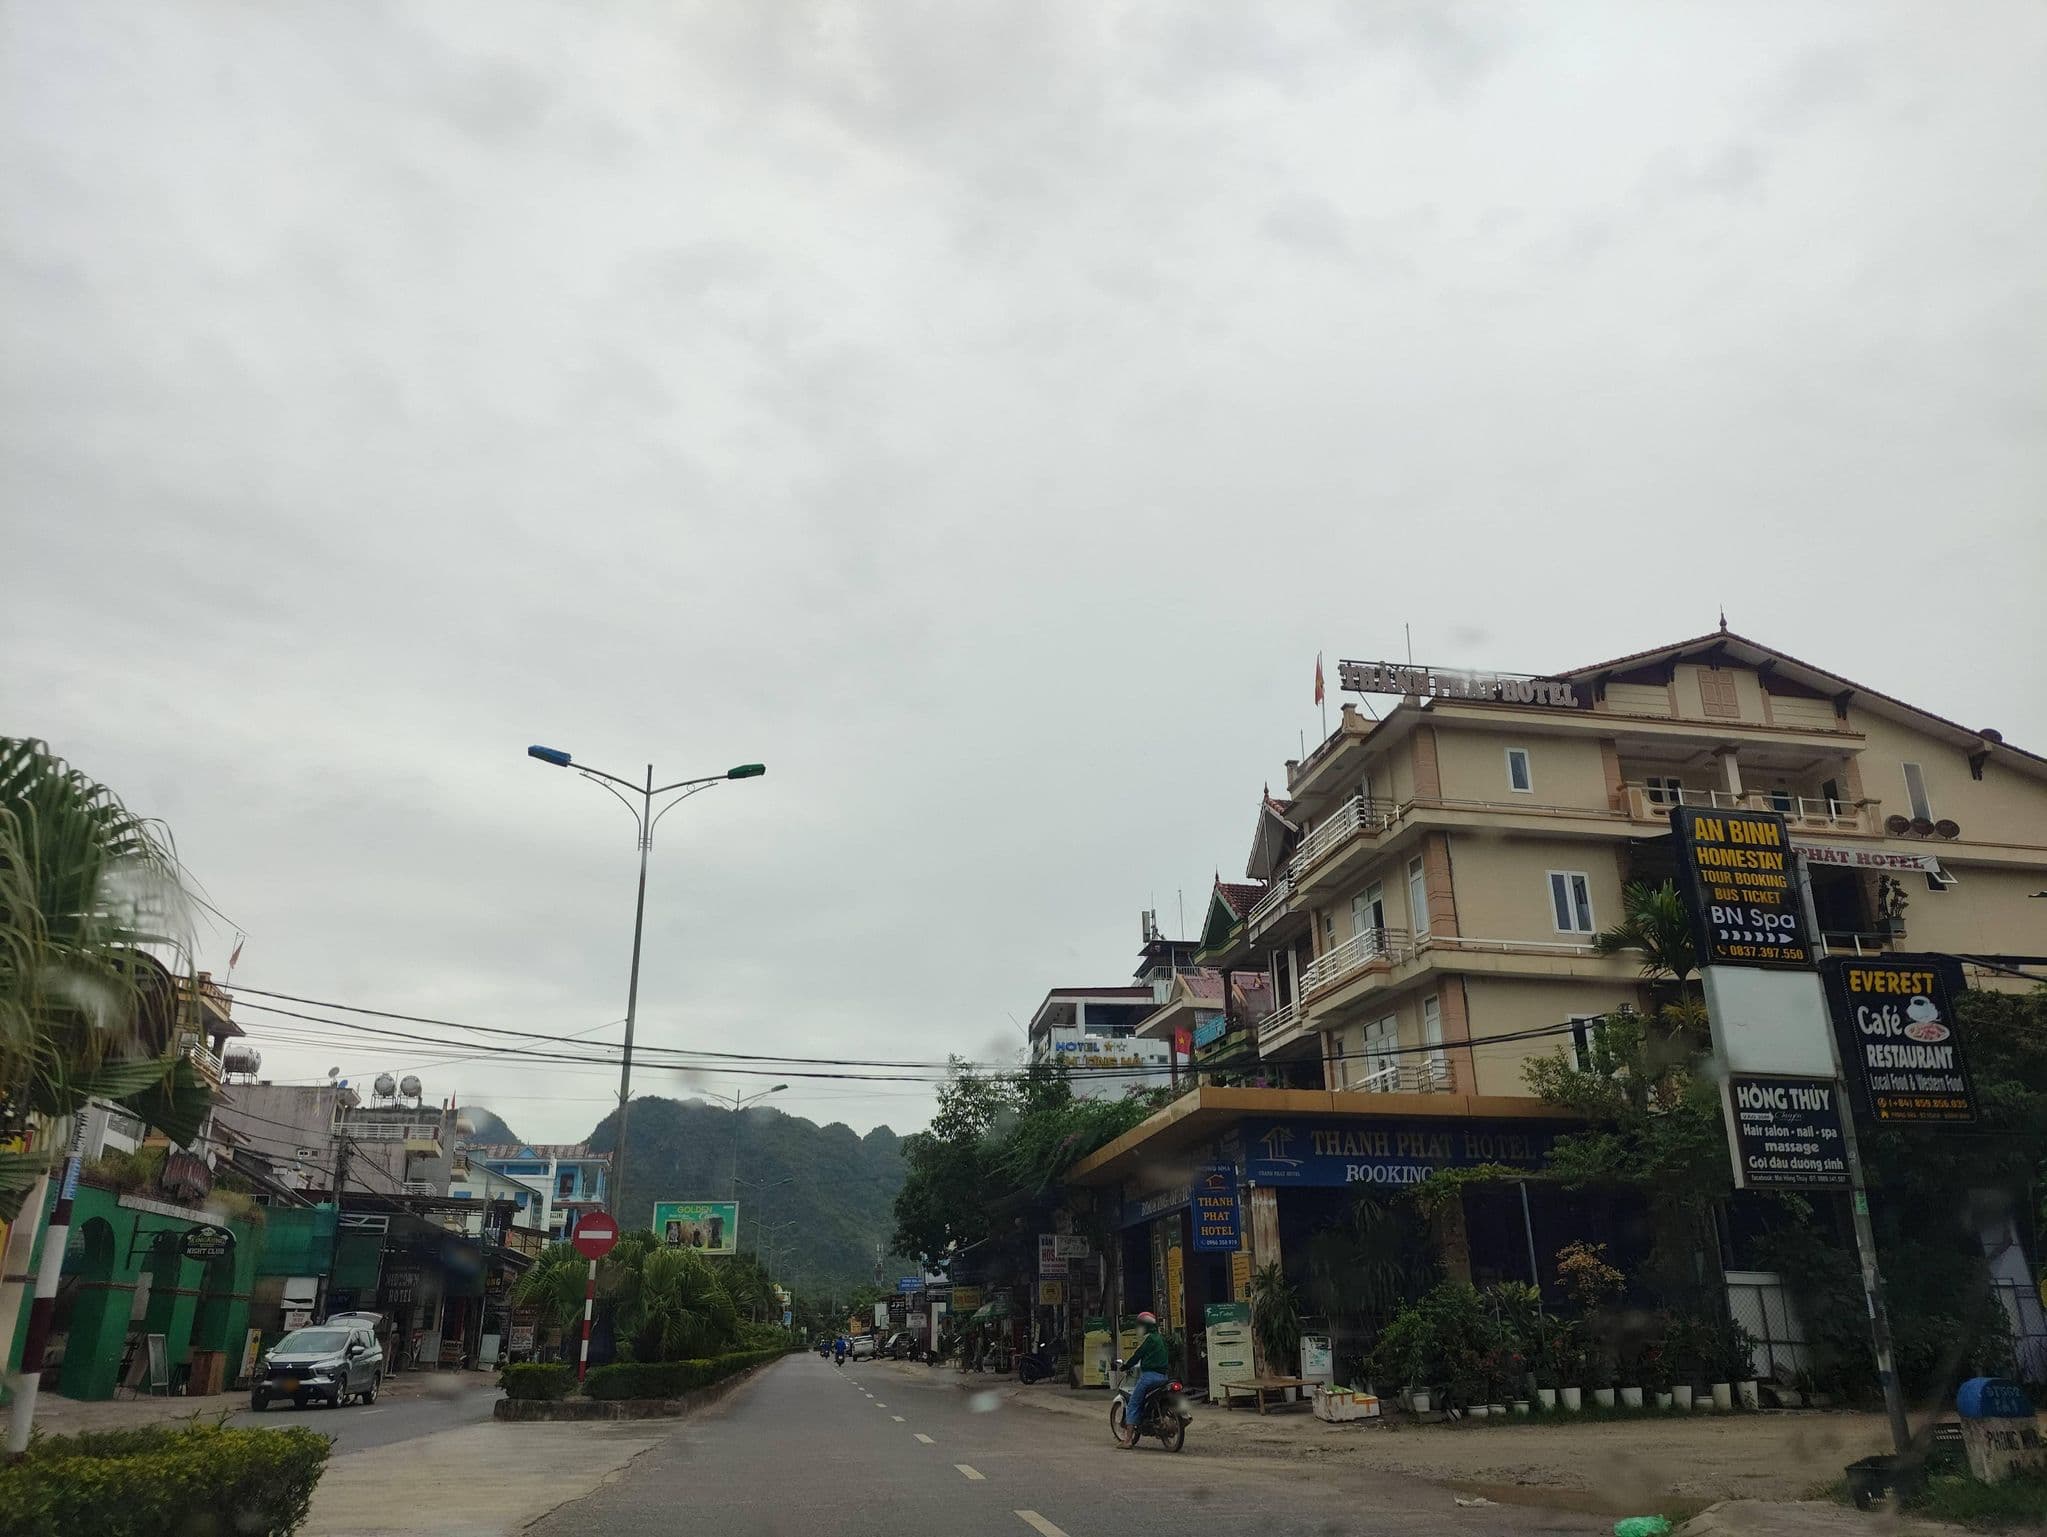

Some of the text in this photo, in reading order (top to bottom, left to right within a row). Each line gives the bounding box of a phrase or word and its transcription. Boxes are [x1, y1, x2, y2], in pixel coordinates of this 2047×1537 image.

[1501, 678, 1579, 707] HOTEL
[1695, 817, 1780, 847] AN BINH
[1697, 847, 1784, 870] HOMESTAY
[1855, 852, 1925, 869] HOTEL
[1701, 869, 1788, 888] TOUR BOOKING
[1714, 887, 1781, 904] BUS TICKET
[1711, 906, 1796, 931] BN Spa
[1729, 944, 1804, 960] 0837.397.550
[1849, 969, 1934, 995] EVEREST
[1857, 1004, 1903, 1038] Café
[1056, 1042, 1100, 1052] HOTEL
[1866, 1044, 1954, 1069] RESTAURANT
[1890, 1072, 1908, 1091] Food
[1946, 1074, 1964, 1092] Food
[1743, 1123, 1838, 1140] Hair salon nail spa
[1312, 1129, 1538, 1160] THANH PHAT HOTEL
[1764, 1141, 1820, 1155] massage
[1824, 1158, 1845, 1170] sinh
[678, 1205, 713, 1214] GOLDEN
[1198, 1197, 1233, 1207] THANH
[1203, 1211, 1230, 1221] PHAT
[1200, 1226, 1235, 1236] HOTEL
